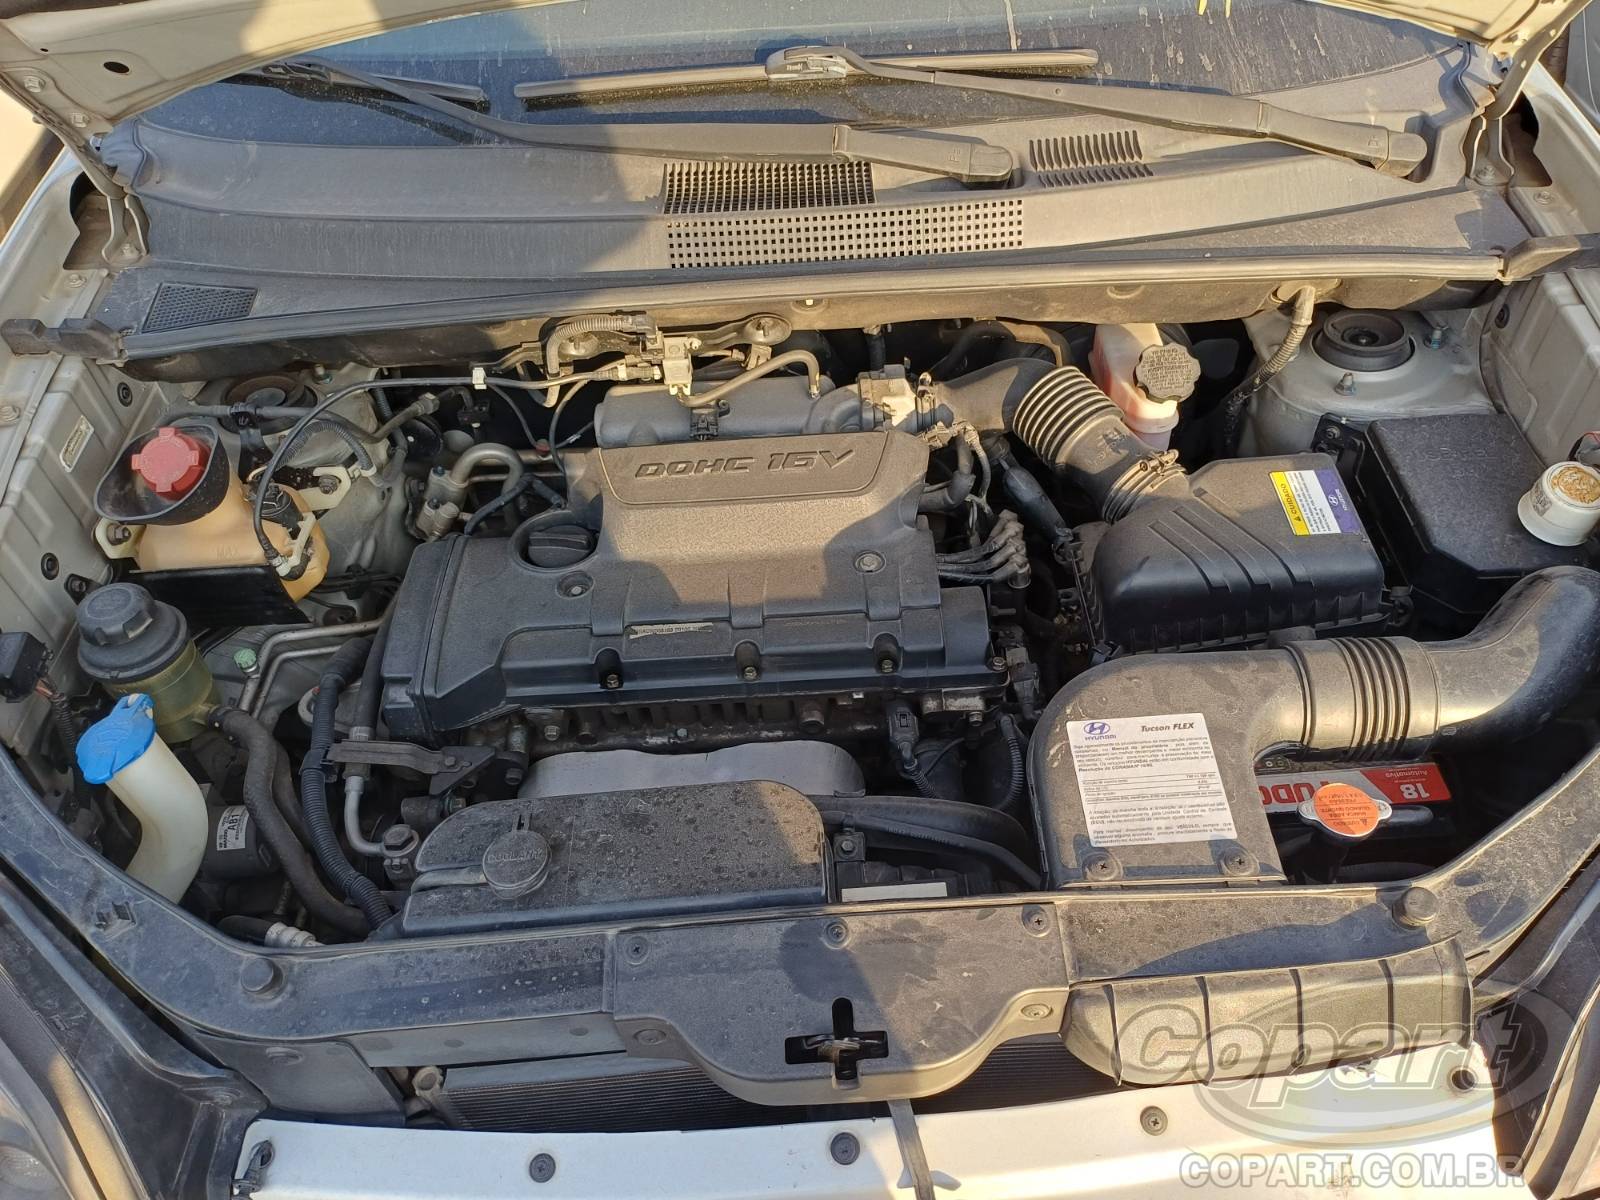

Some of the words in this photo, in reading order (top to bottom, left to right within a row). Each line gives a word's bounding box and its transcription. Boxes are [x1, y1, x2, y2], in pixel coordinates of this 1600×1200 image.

[635, 456, 755, 478] DOHC
[767, 449, 855, 472] 16V
[1280, 484, 1297, 514] CUIDADO
[1141, 724, 1170, 732] Tucson
[1172, 722, 1194, 730] FLEX
[1400, 784, 1430, 800] 18
